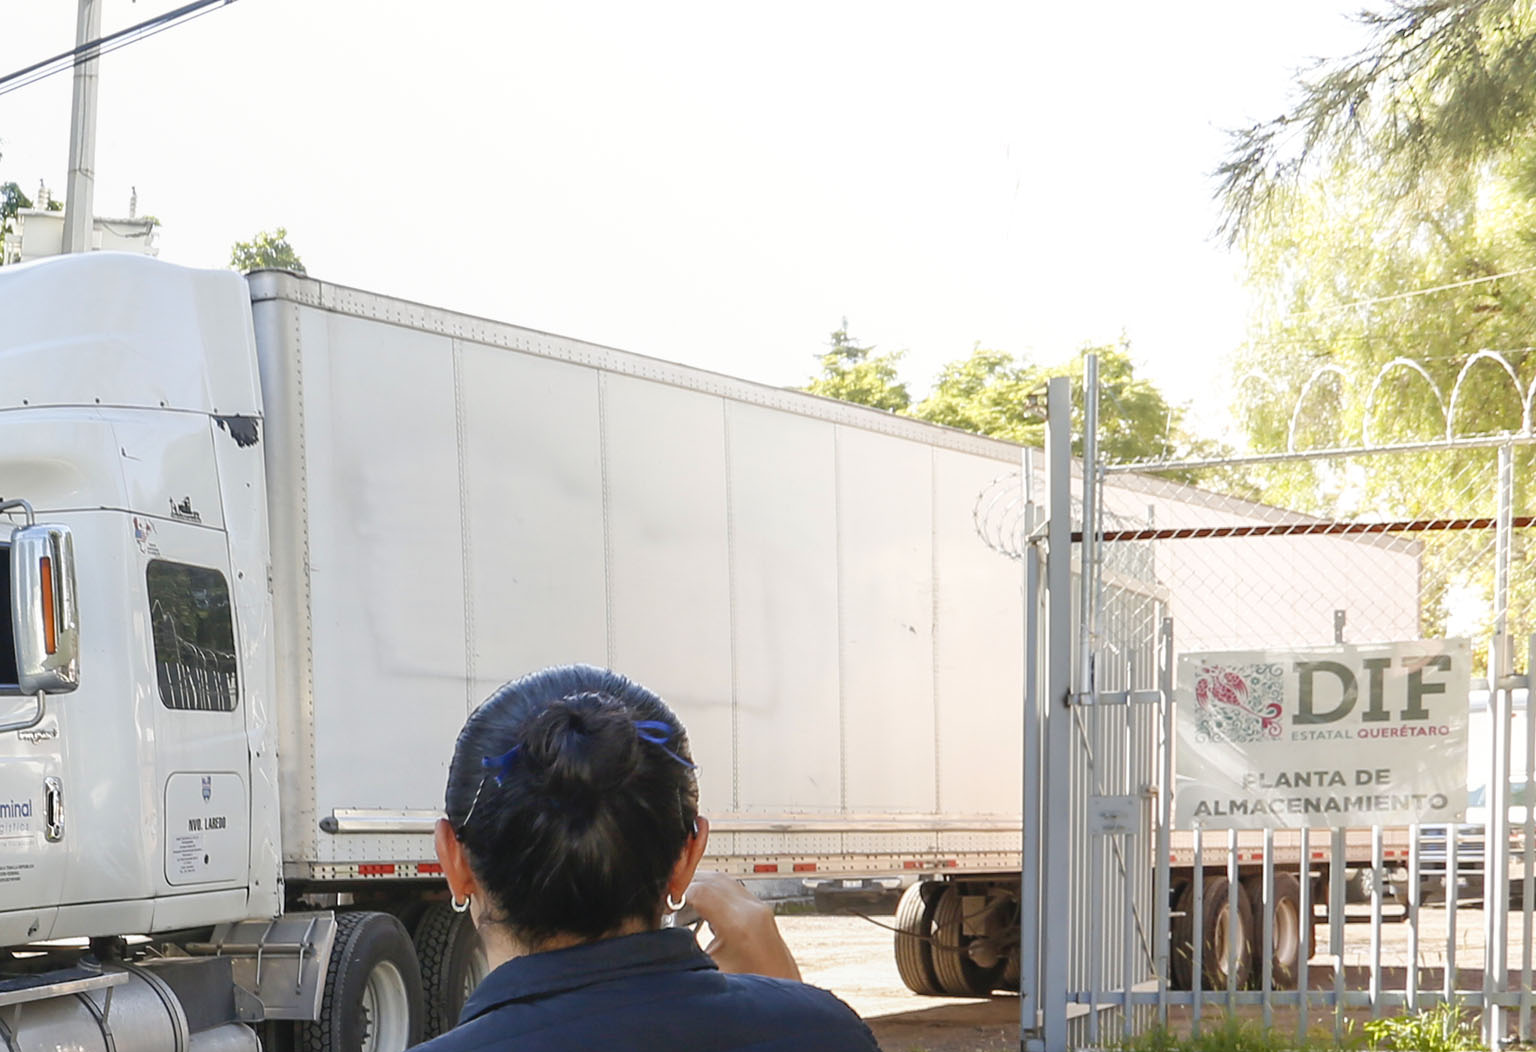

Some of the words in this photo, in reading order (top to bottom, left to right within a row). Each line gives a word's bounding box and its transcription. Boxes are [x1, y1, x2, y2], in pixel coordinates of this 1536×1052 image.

[1291, 654, 1451, 725] DIF
[1291, 728, 1354, 741] ESTATAL
[1356, 724, 1450, 740] QUERÉTARO
[1242, 770, 1347, 789] PLANTA
[1355, 768, 1391, 786] DE
[1193, 793, 1449, 817] ALMACENAMIENTO
